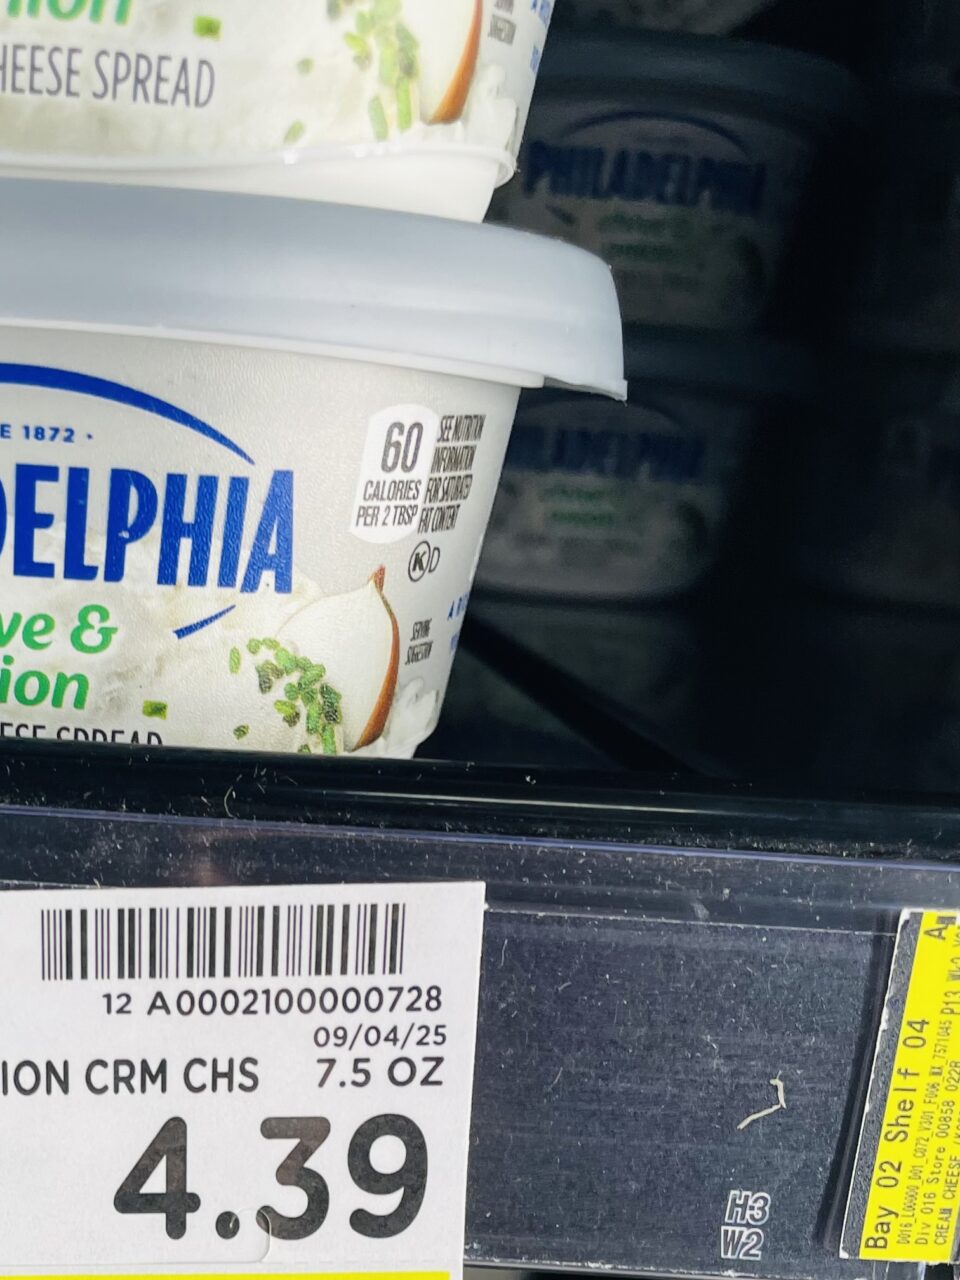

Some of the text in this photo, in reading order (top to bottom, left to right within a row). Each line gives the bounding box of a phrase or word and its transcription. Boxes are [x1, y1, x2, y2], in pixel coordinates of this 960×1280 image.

[93, 50, 215, 109] SPREAD
[22, 424, 76, 444] 1872
[437, 414, 454, 443] SEE
[380, 421, 424, 474] 60
[362, 478, 422, 502] CALORIES
[424, 476, 442, 504] FOR
[355, 503, 419, 528] PER 2 TBSP
[417, 505, 435, 534] FAT
[70, 603, 119, 656] &
[102, 985, 443, 1017] 12 A0002100000728
[313, 1023, 448, 1051] 09/04/25
[902, 1018, 929, 1049] 04
[85, 1058, 168, 1095] CRM
[183, 1057, 260, 1094] CHS
[316, 1057, 372, 1089] 7.5
[387, 1056, 446, 1088] OZ
[884, 1067, 921, 1143] Shelf
[113, 1113, 429, 1241] 4.39
[876, 1160, 902, 1188] 02
[915, 1099, 955, 1245] Div 016 Store 00858
[724, 1190, 772, 1226] H3
[720, 1225, 765, 1262] W2
[864, 1206, 899, 1249] Bay
[934, 1207, 953, 1246] CREAM
